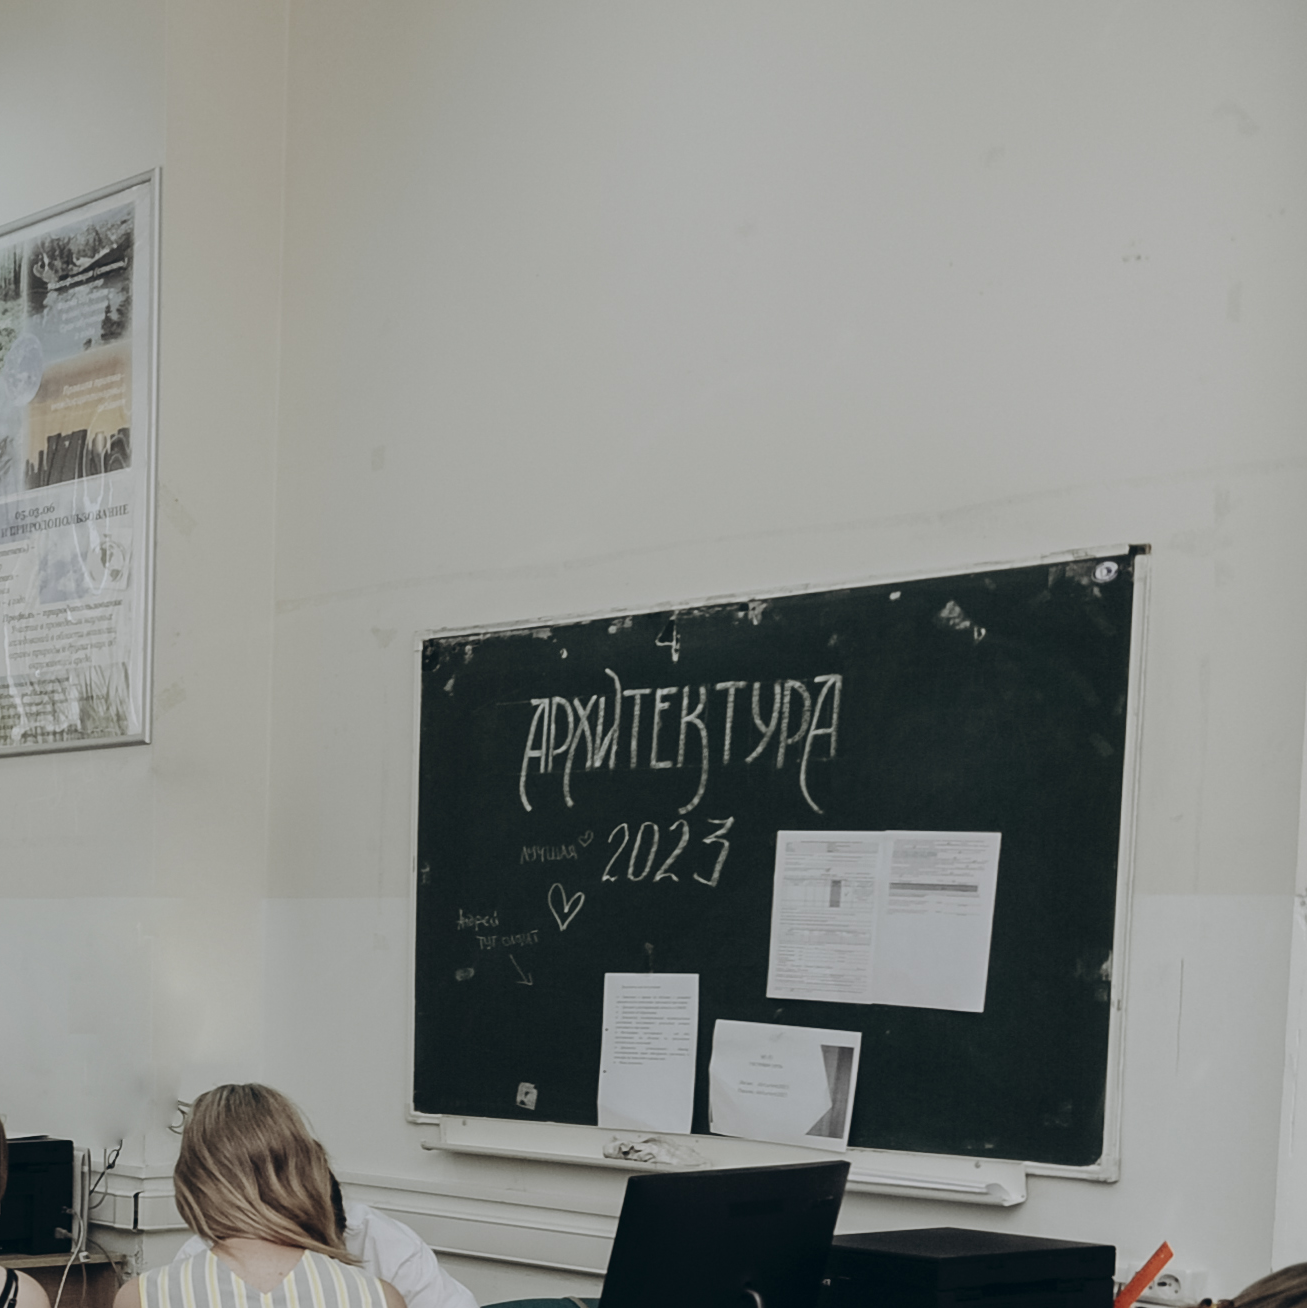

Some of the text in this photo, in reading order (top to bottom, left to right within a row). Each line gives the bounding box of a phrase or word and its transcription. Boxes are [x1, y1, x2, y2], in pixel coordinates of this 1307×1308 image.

[14, 503, 55, 521] 05.03.06
[519, 668, 844, 814] АРХИТЕКТУРА
[520, 845, 577, 864] ЛУЧШАЯ
[601, 816, 735, 887] 2023
